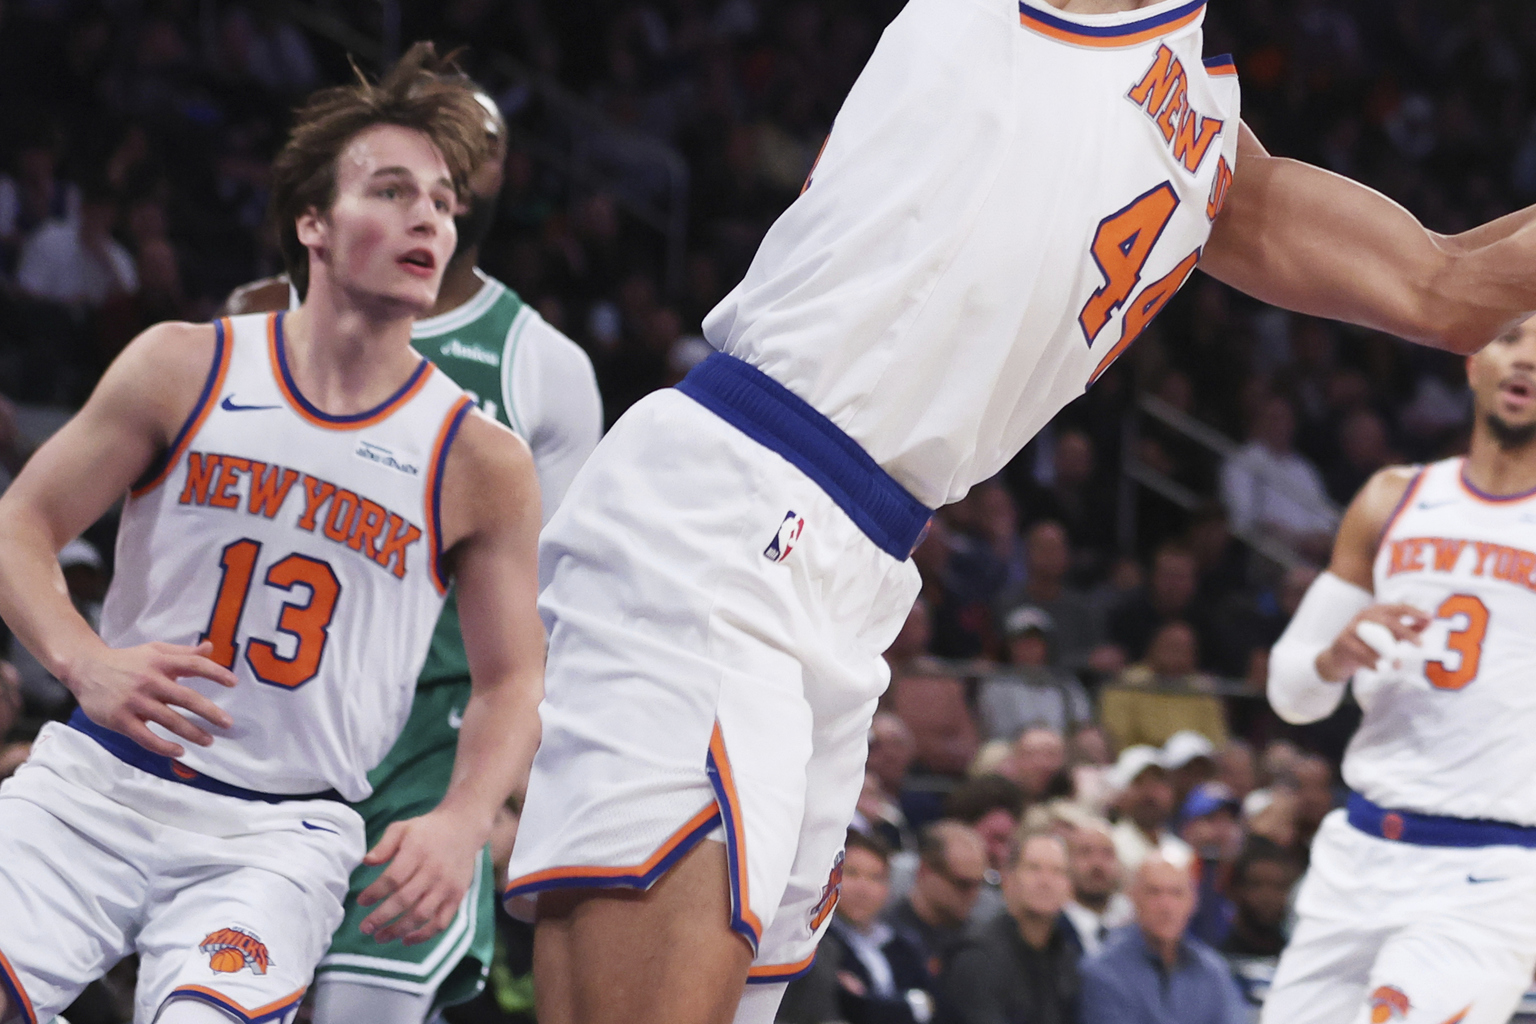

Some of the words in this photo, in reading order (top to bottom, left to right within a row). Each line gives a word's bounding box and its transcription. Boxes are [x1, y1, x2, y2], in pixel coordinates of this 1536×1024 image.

[1126, 43, 1224, 176] NEW
[1078, 179, 1202, 392] 44
[179, 451, 298, 520] NEW
[298, 475, 421, 580] YORK
[1387, 537, 1469, 579] NEW
[199, 537, 342, 691] 13
[1423, 593, 1490, 691] 3
